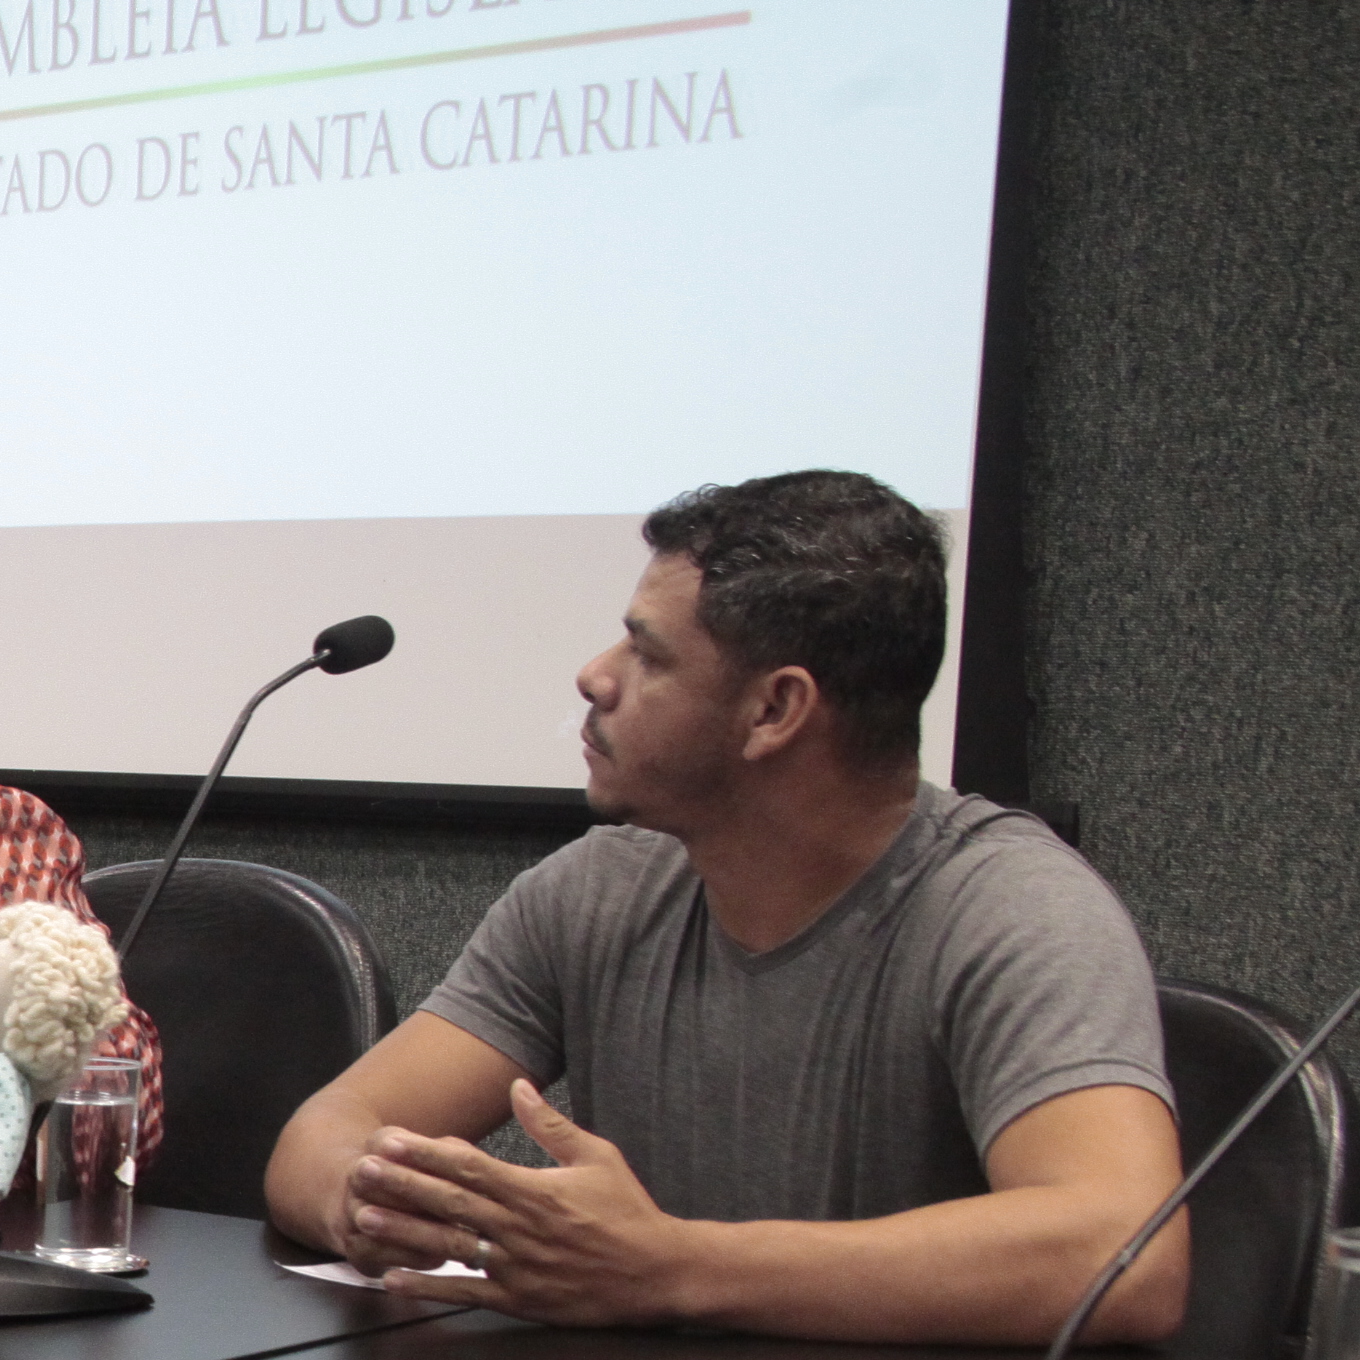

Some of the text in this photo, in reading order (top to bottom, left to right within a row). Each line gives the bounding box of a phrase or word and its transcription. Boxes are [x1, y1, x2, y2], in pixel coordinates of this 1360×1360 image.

[135, 131, 200, 202] DE
[221, 108, 401, 193] SANTA
[420, 67, 745, 171] CATARINA
